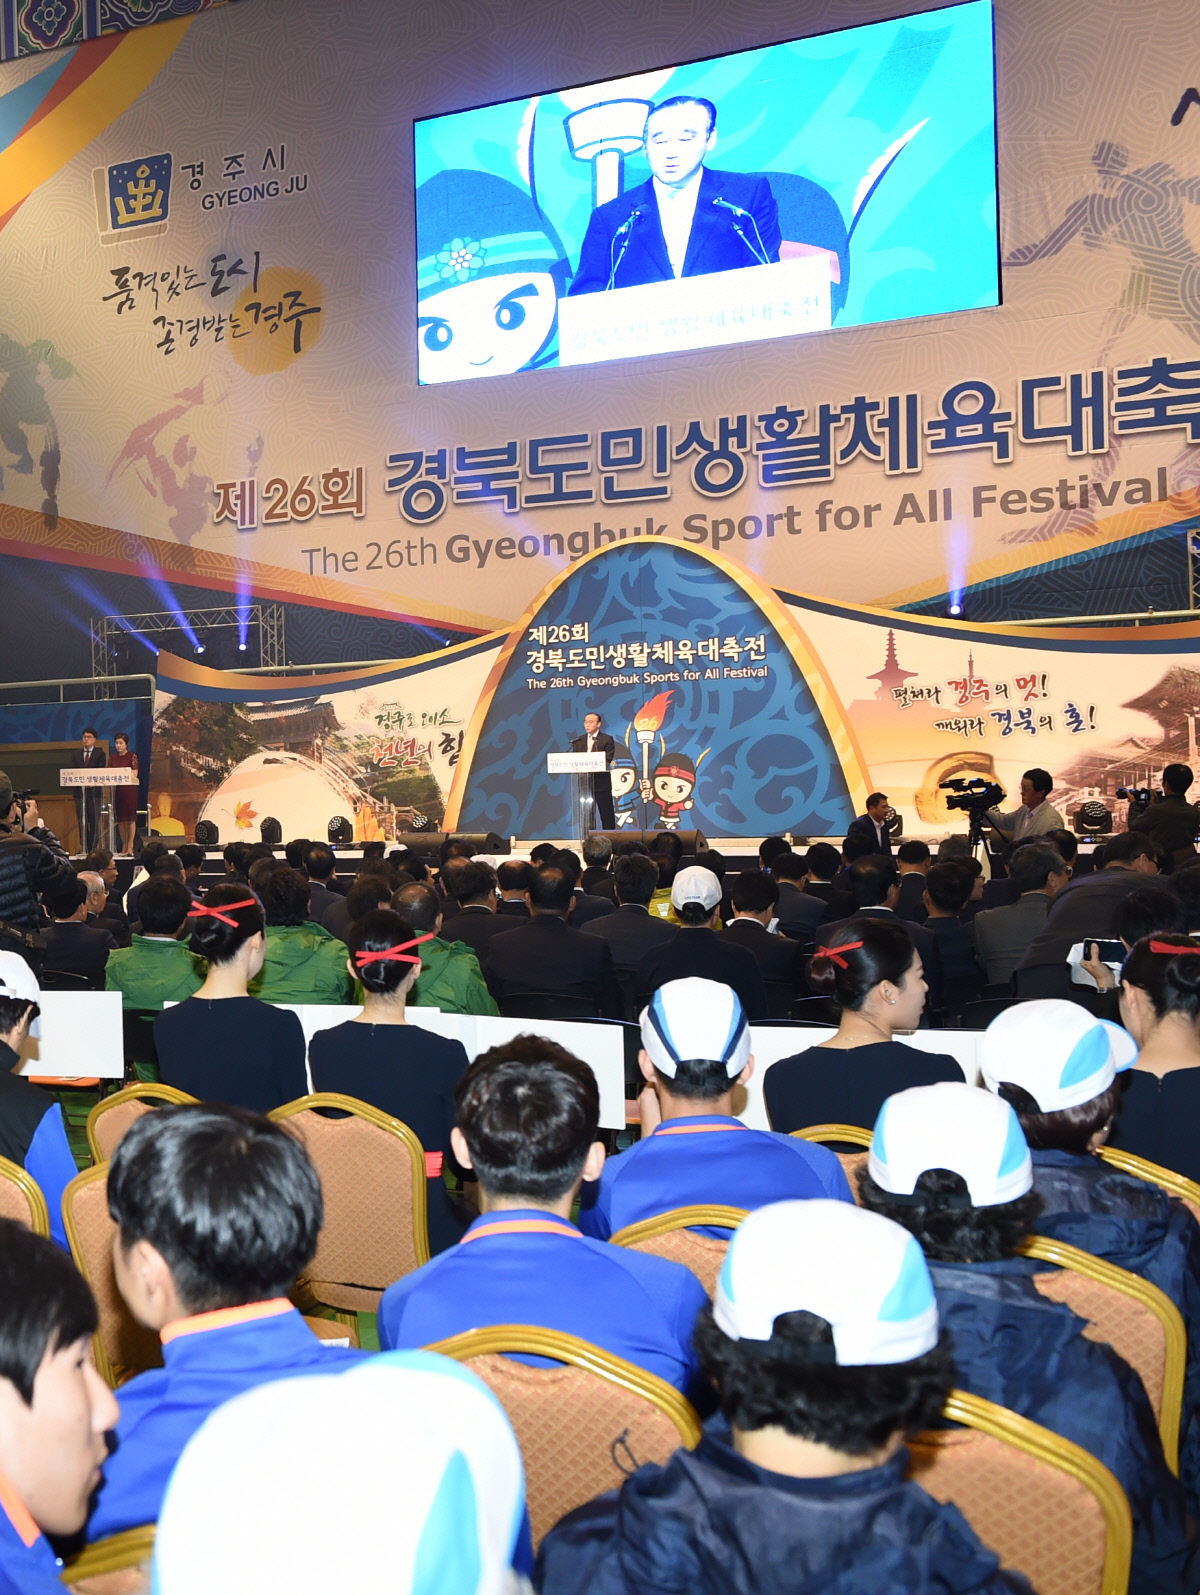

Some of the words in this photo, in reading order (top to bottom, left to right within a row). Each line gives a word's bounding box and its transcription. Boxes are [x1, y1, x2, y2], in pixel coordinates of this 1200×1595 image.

[202, 181, 280, 210] GYEONG
[284, 174, 308, 194] JU
[214, 466, 364, 528] 제26회
[302, 547, 359, 576] The
[365, 537, 437, 570] 26th
[683, 505, 801, 550] Sport
[816, 499, 881, 532] for
[893, 488, 953, 525] All
[972, 466, 1168, 518] Festival
[528, 622, 590, 646] 제26회
[526, 634, 767, 674] 경북도민생활체육대축전
[527, 678, 547, 690] The
[550, 676, 574, 688] 26th
[577, 673, 640, 689] Gyeongbuk
[643, 670, 680, 685] Sports
[683, 669, 701, 681] for
[704, 668, 720, 680] All
[723, 666, 768, 679] Festival
[639, 716, 658, 730] 26
